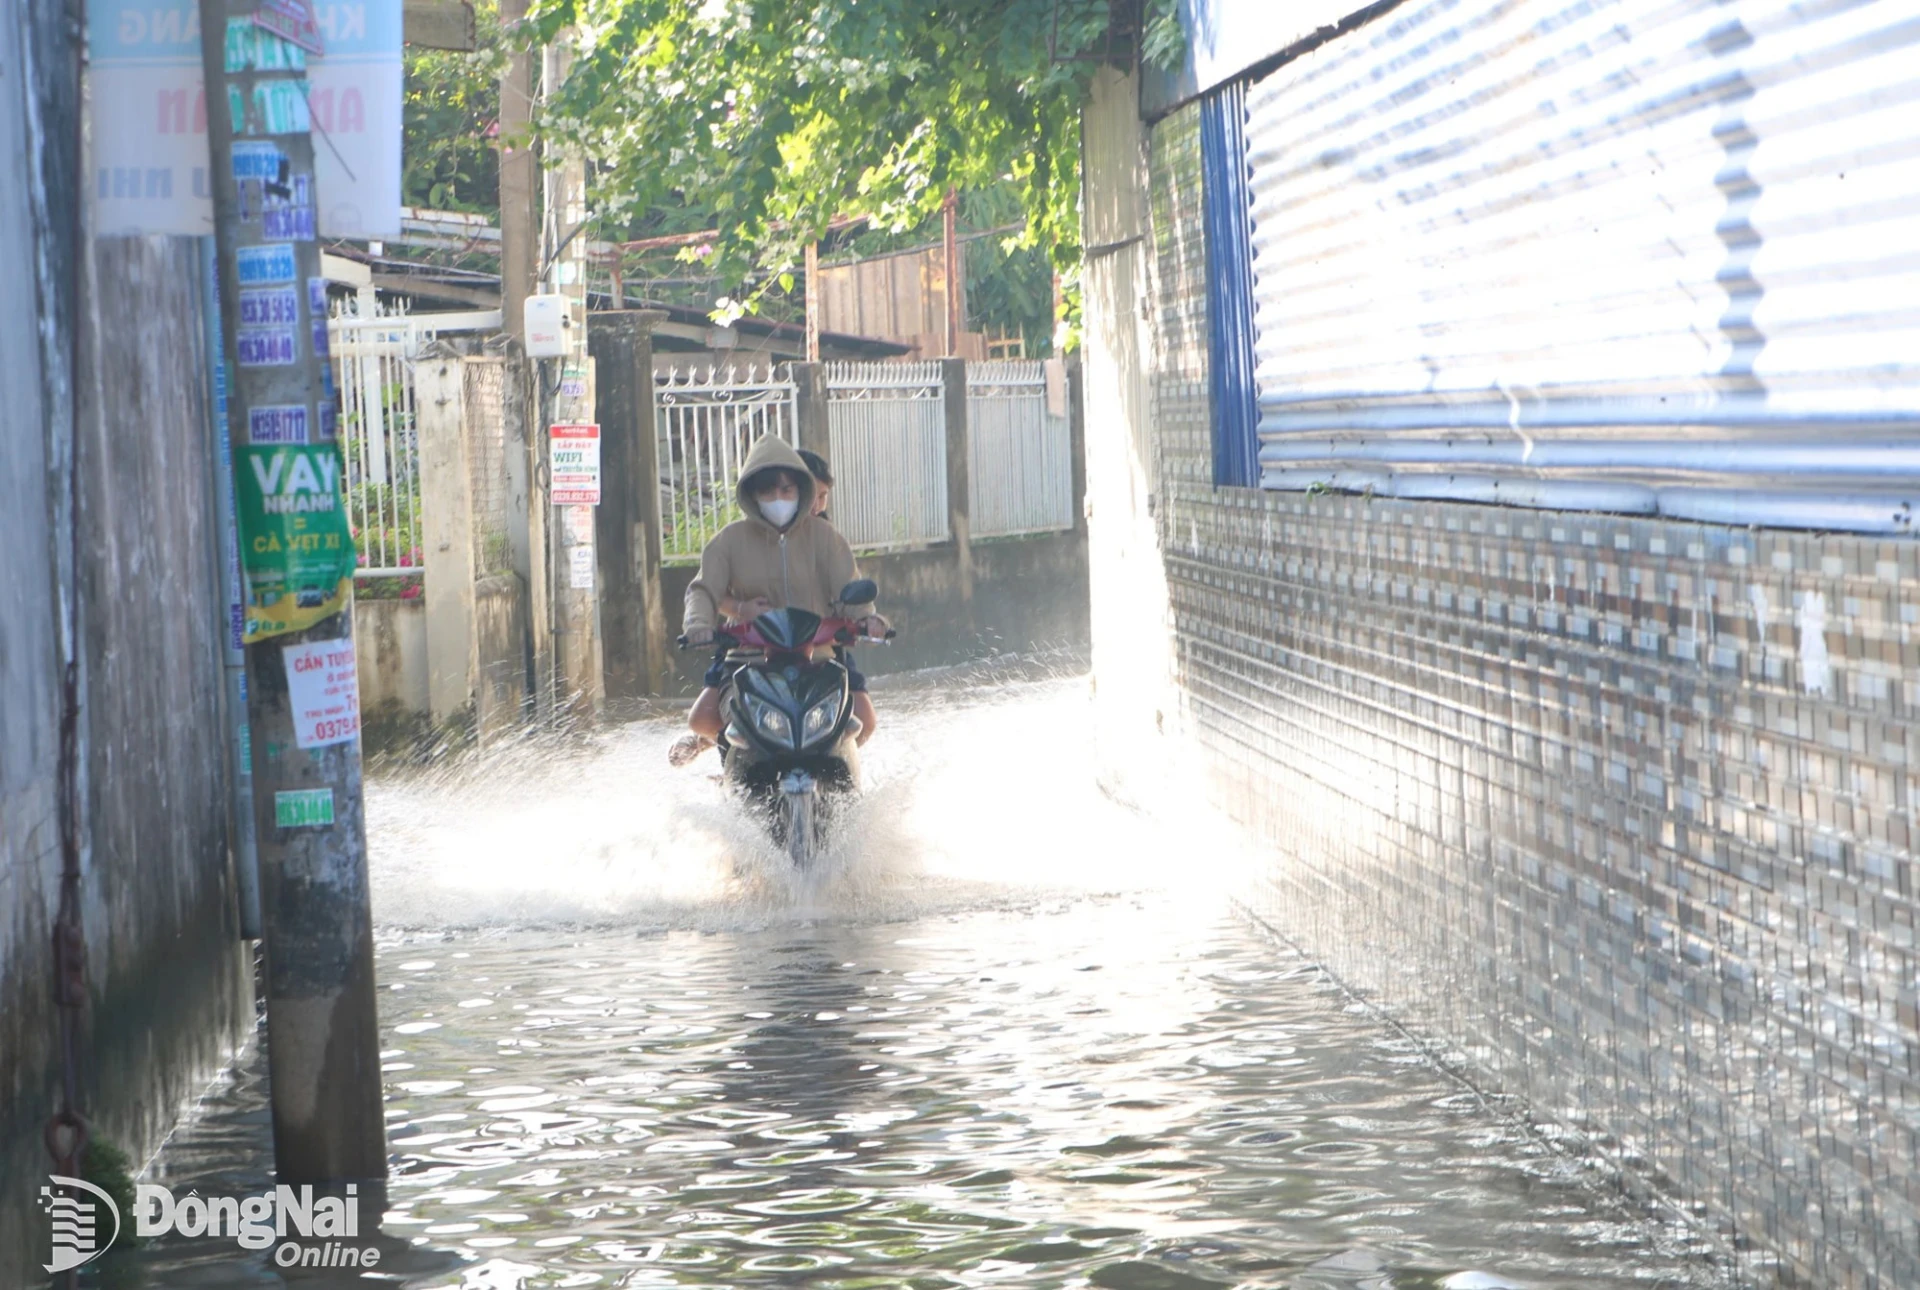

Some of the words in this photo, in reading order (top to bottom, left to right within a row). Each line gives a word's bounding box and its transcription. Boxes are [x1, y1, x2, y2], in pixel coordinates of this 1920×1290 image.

[553, 451, 583, 463] WIFI
[249, 452, 336, 495] VAY
[263, 494, 335, 514] NHANH
